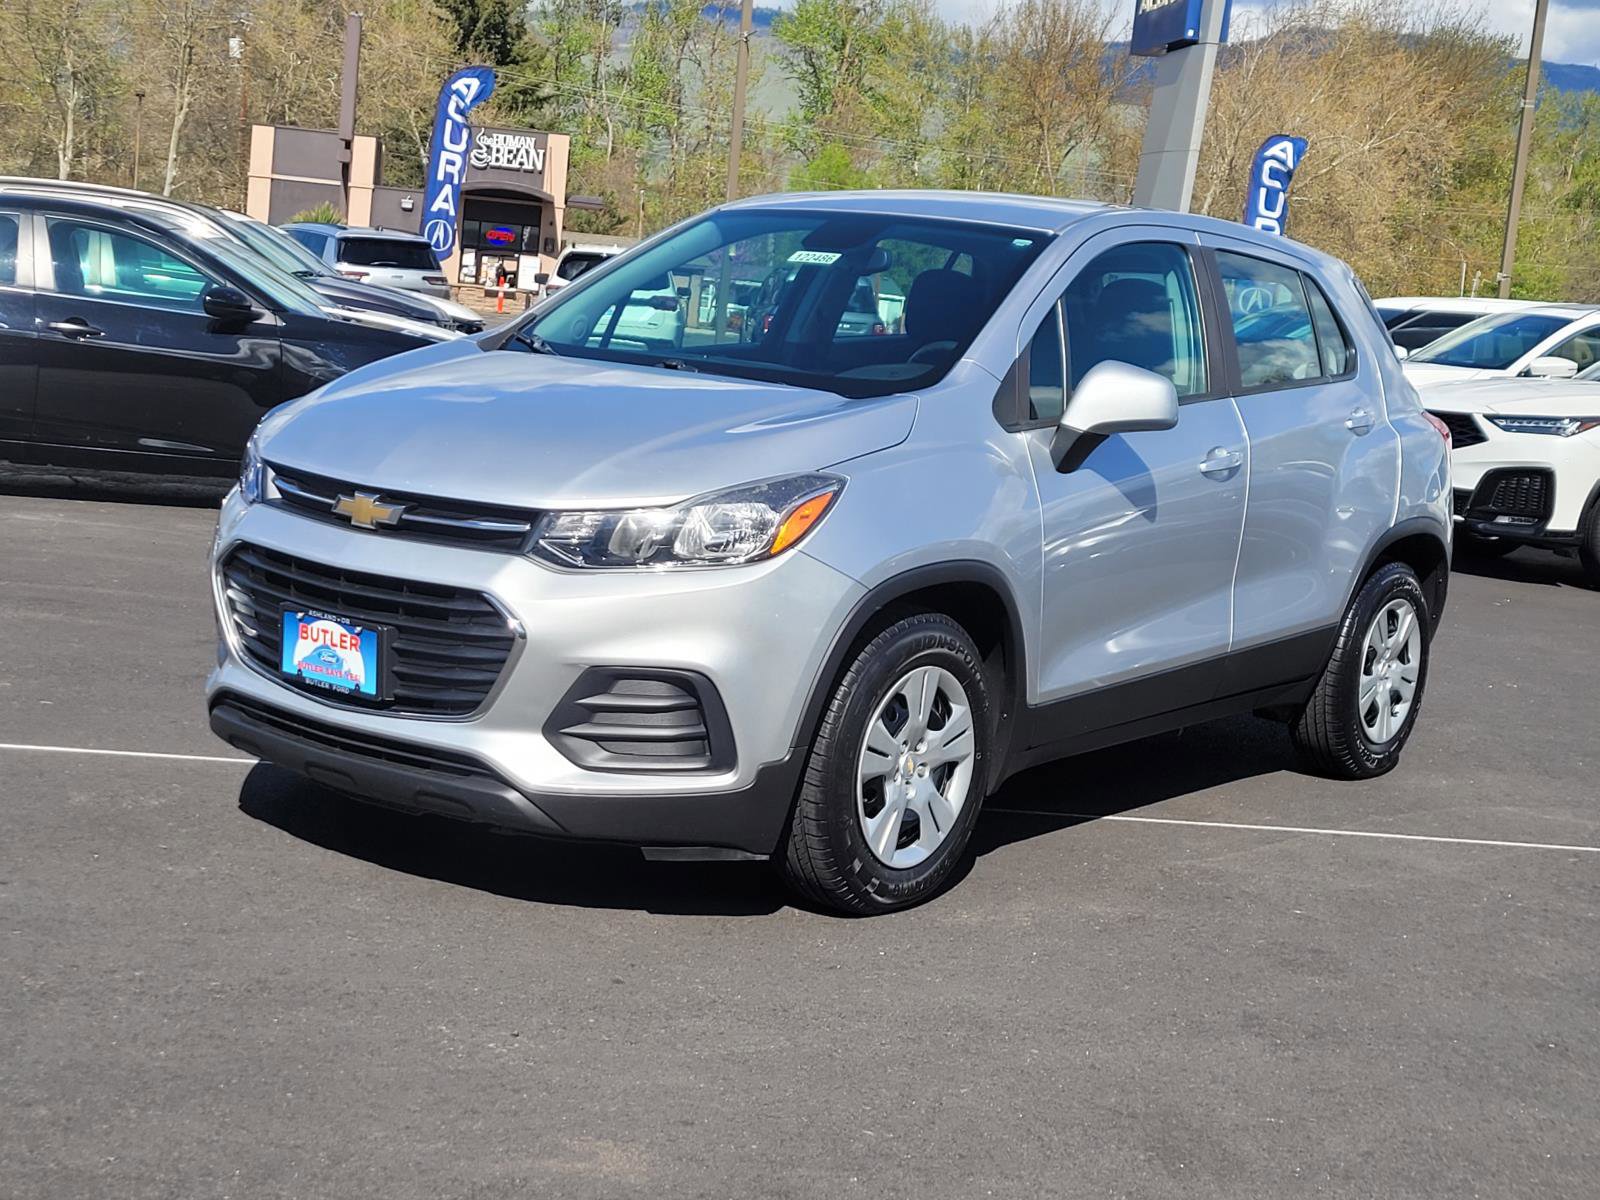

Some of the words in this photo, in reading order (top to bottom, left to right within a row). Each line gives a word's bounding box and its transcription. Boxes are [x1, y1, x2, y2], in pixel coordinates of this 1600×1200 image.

[430, 77, 480, 216] ACURA
[492, 133, 536, 149] HUMAN
[489, 145, 545, 171] BEAN
[486, 229, 516, 242] OPEN
[299, 623, 360, 652] BUTLER
